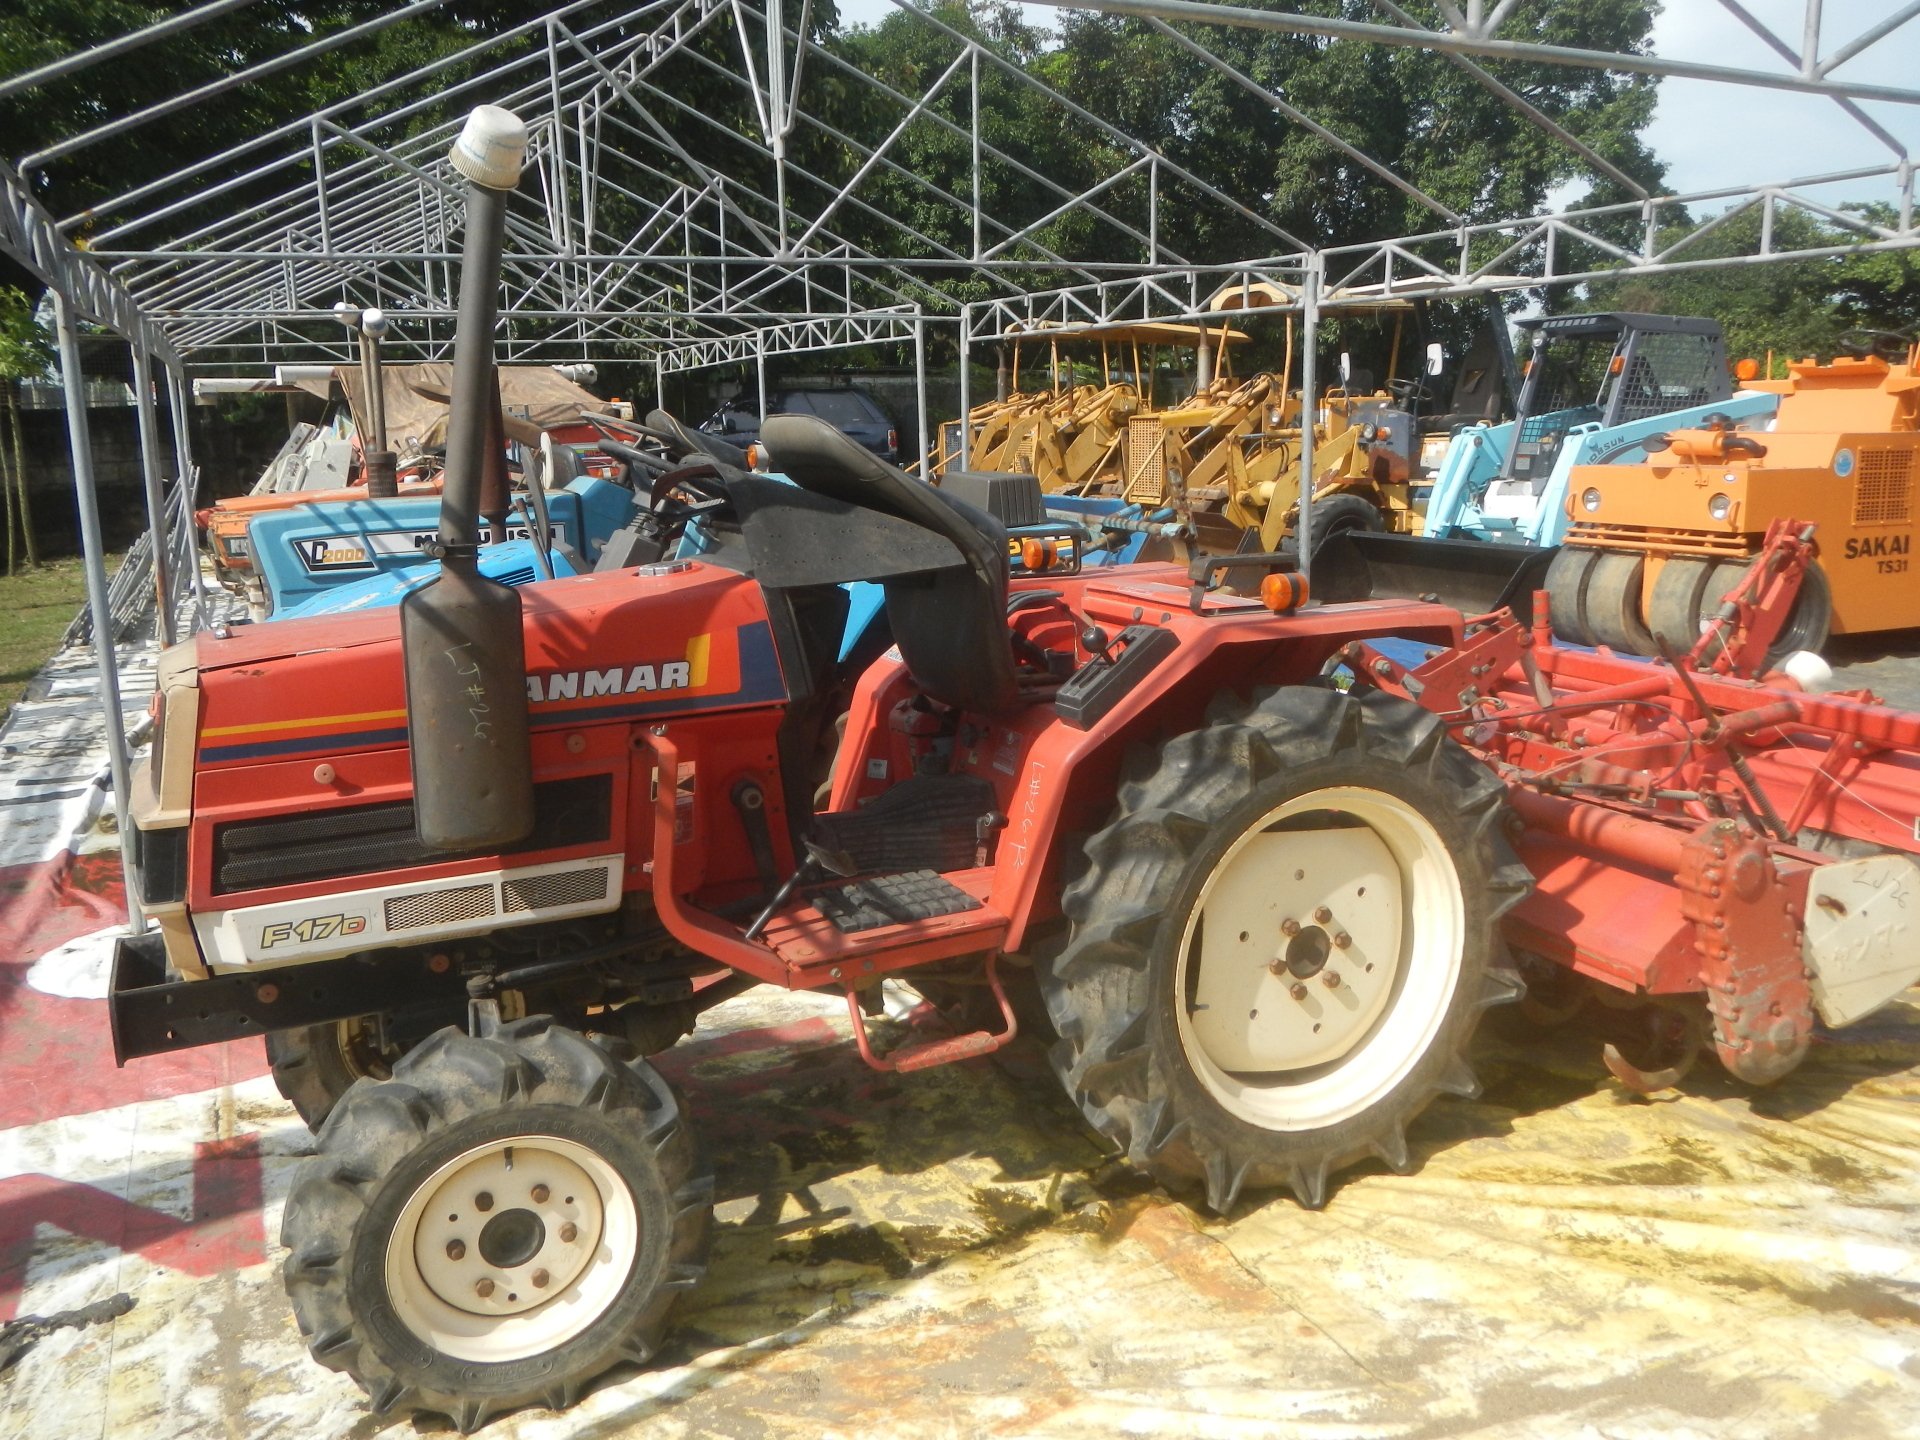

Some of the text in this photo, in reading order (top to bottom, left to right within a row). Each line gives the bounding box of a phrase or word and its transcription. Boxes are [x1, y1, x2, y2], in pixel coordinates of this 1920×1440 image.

[1844, 535, 1910, 559] SAKAI
[1876, 559, 1909, 574] TS31
[524, 660, 691, 703] ANMAR
[260, 913, 366, 949] F17D
